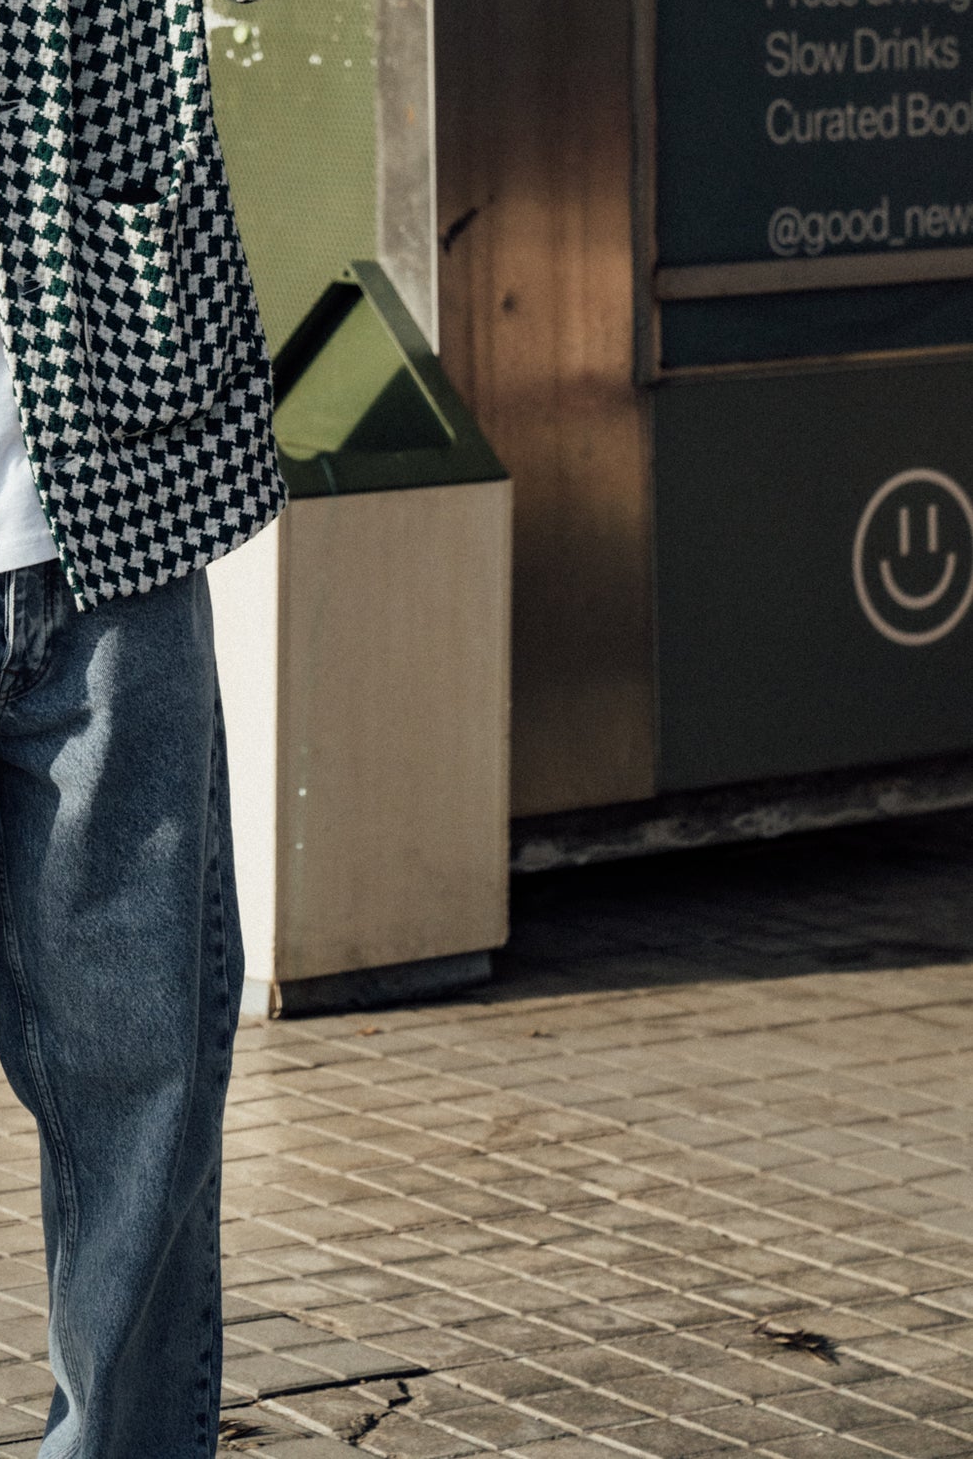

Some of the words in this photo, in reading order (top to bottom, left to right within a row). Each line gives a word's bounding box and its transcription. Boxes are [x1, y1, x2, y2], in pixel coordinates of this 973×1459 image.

[765, 29, 849, 77] Slow
[854, 26, 960, 73] Drinks
[766, 93, 900, 145] Curated
[906, 91, 973, 138] Boo
